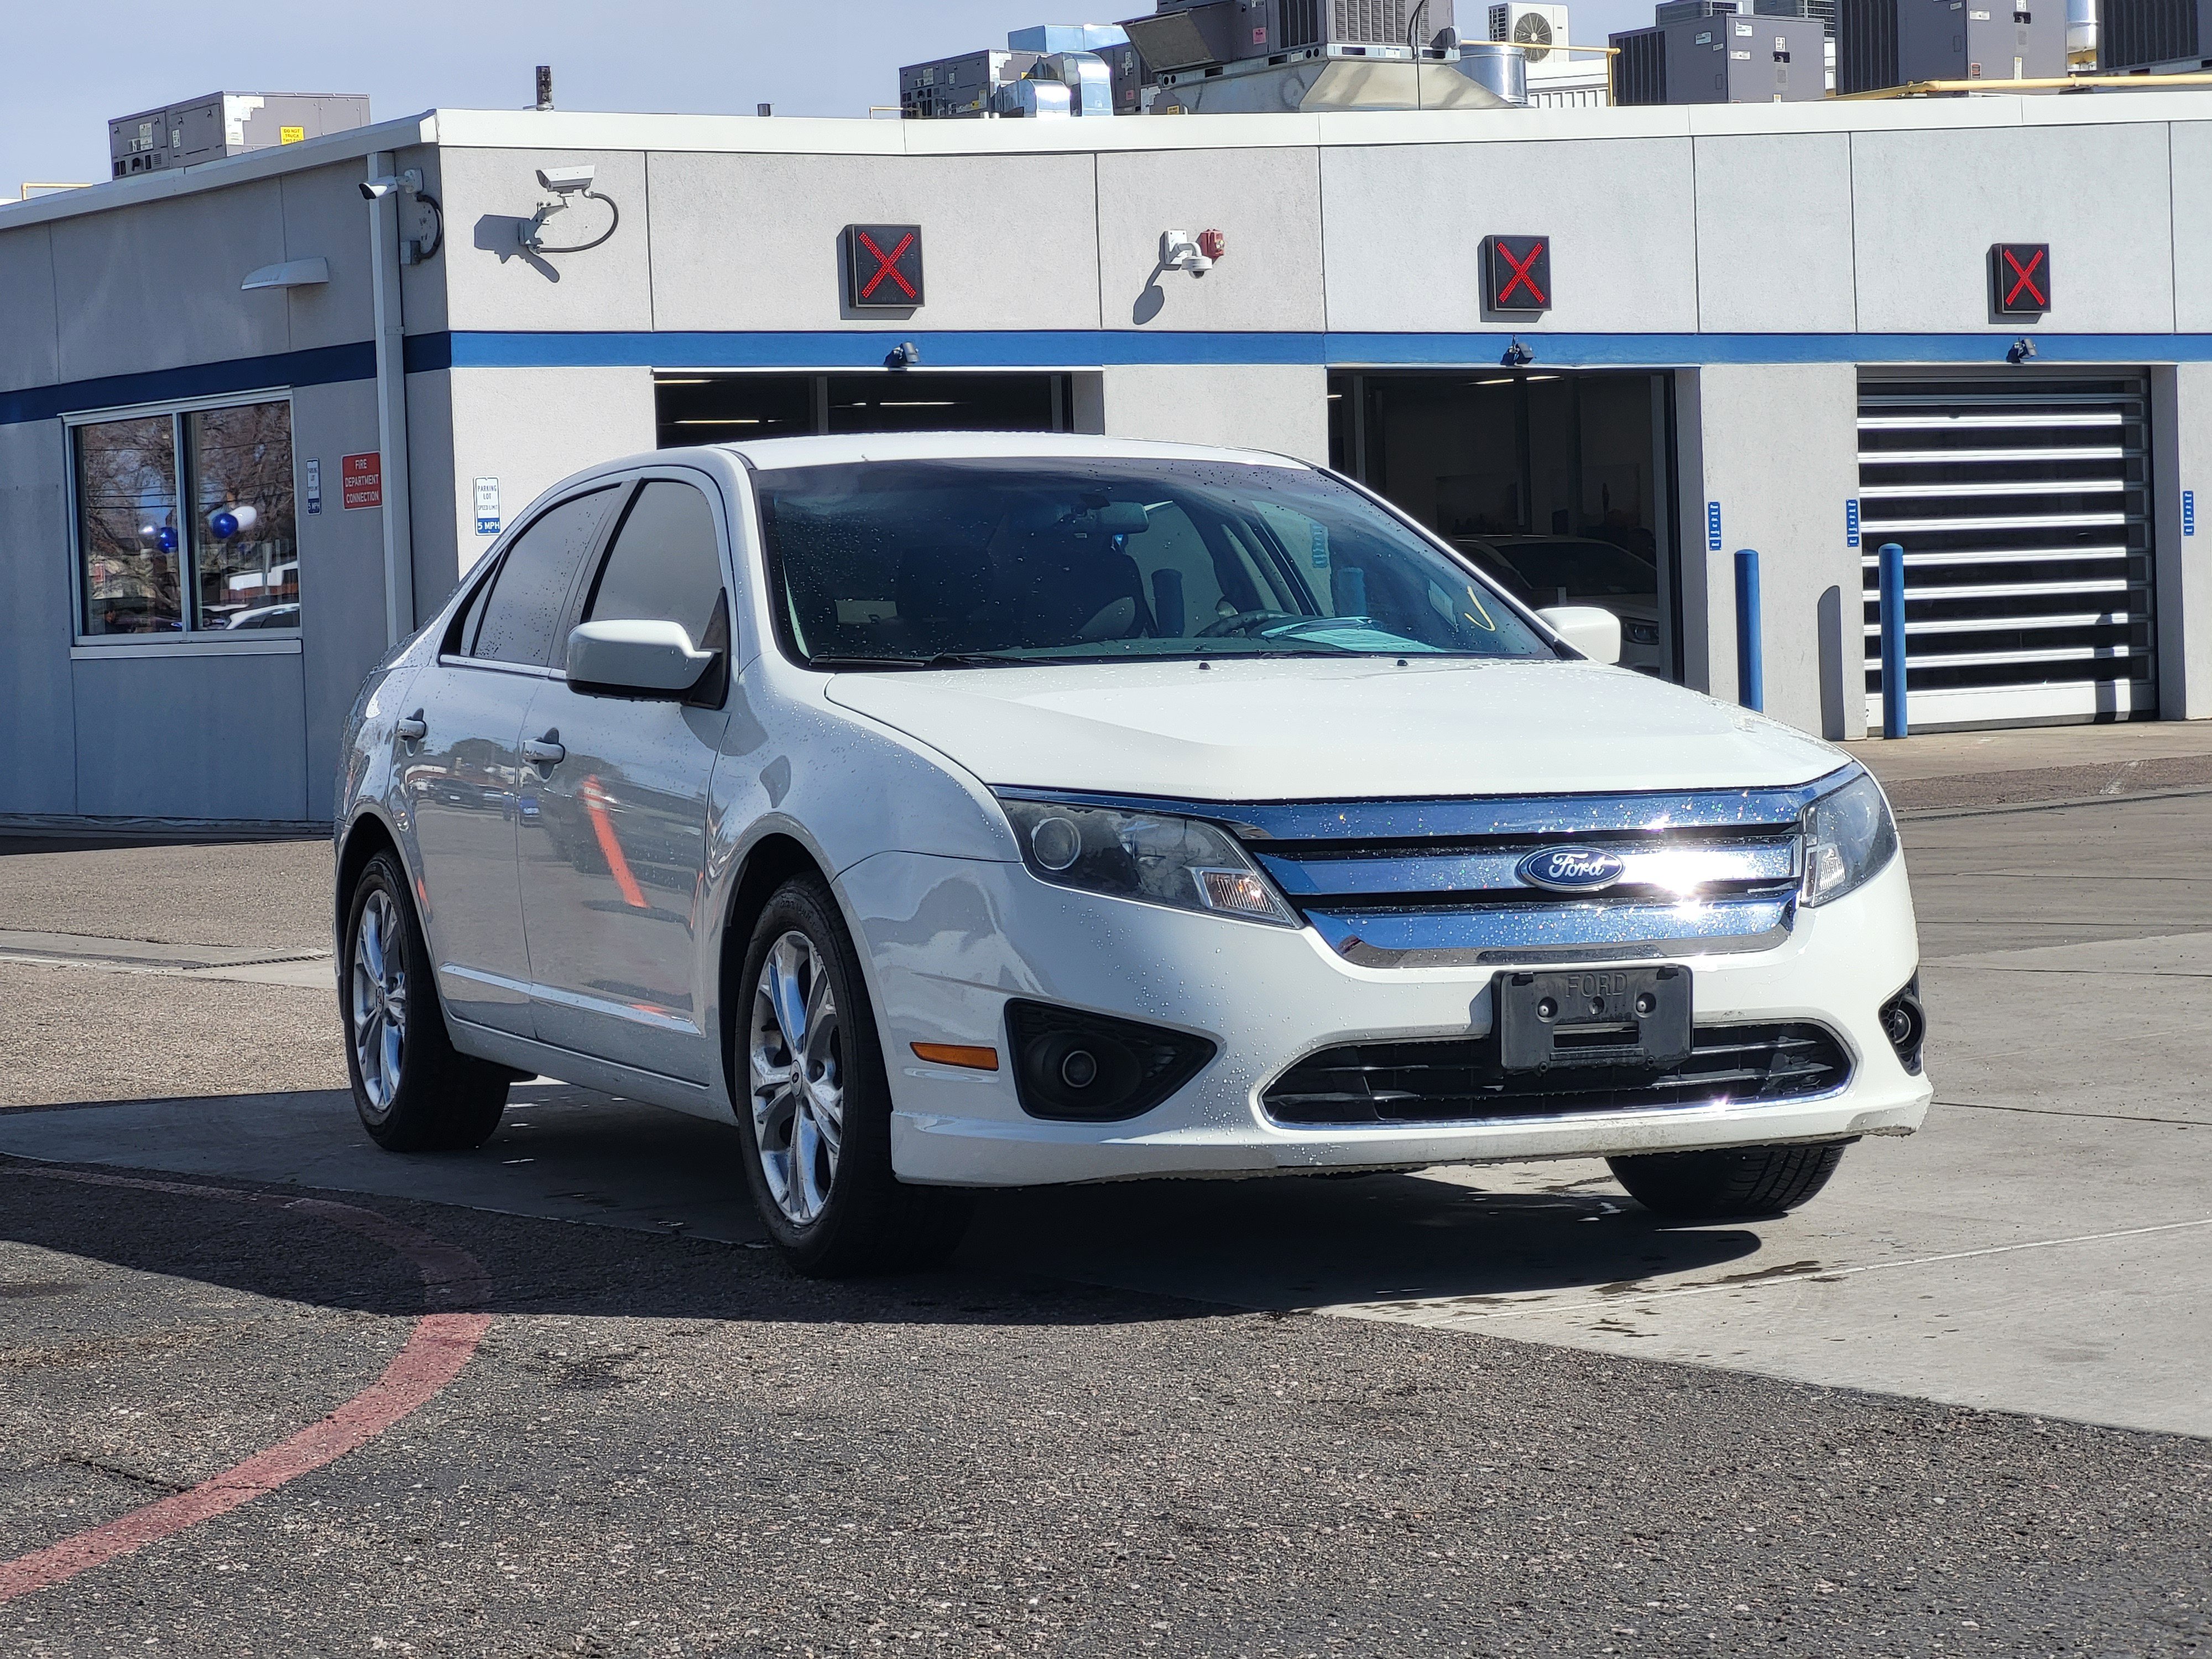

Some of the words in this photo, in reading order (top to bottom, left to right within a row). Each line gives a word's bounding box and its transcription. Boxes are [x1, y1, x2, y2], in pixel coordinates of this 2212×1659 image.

[355, 458, 367, 470] FIRE
[345, 473, 379, 488] DEPARTMENT
[346, 491, 379, 504] CONNECTION
[477, 521, 483, 530] 5
[484, 521, 500, 530] MPH
[1548, 853, 1605, 878] Ford
[1565, 973, 1627, 997] FORD
